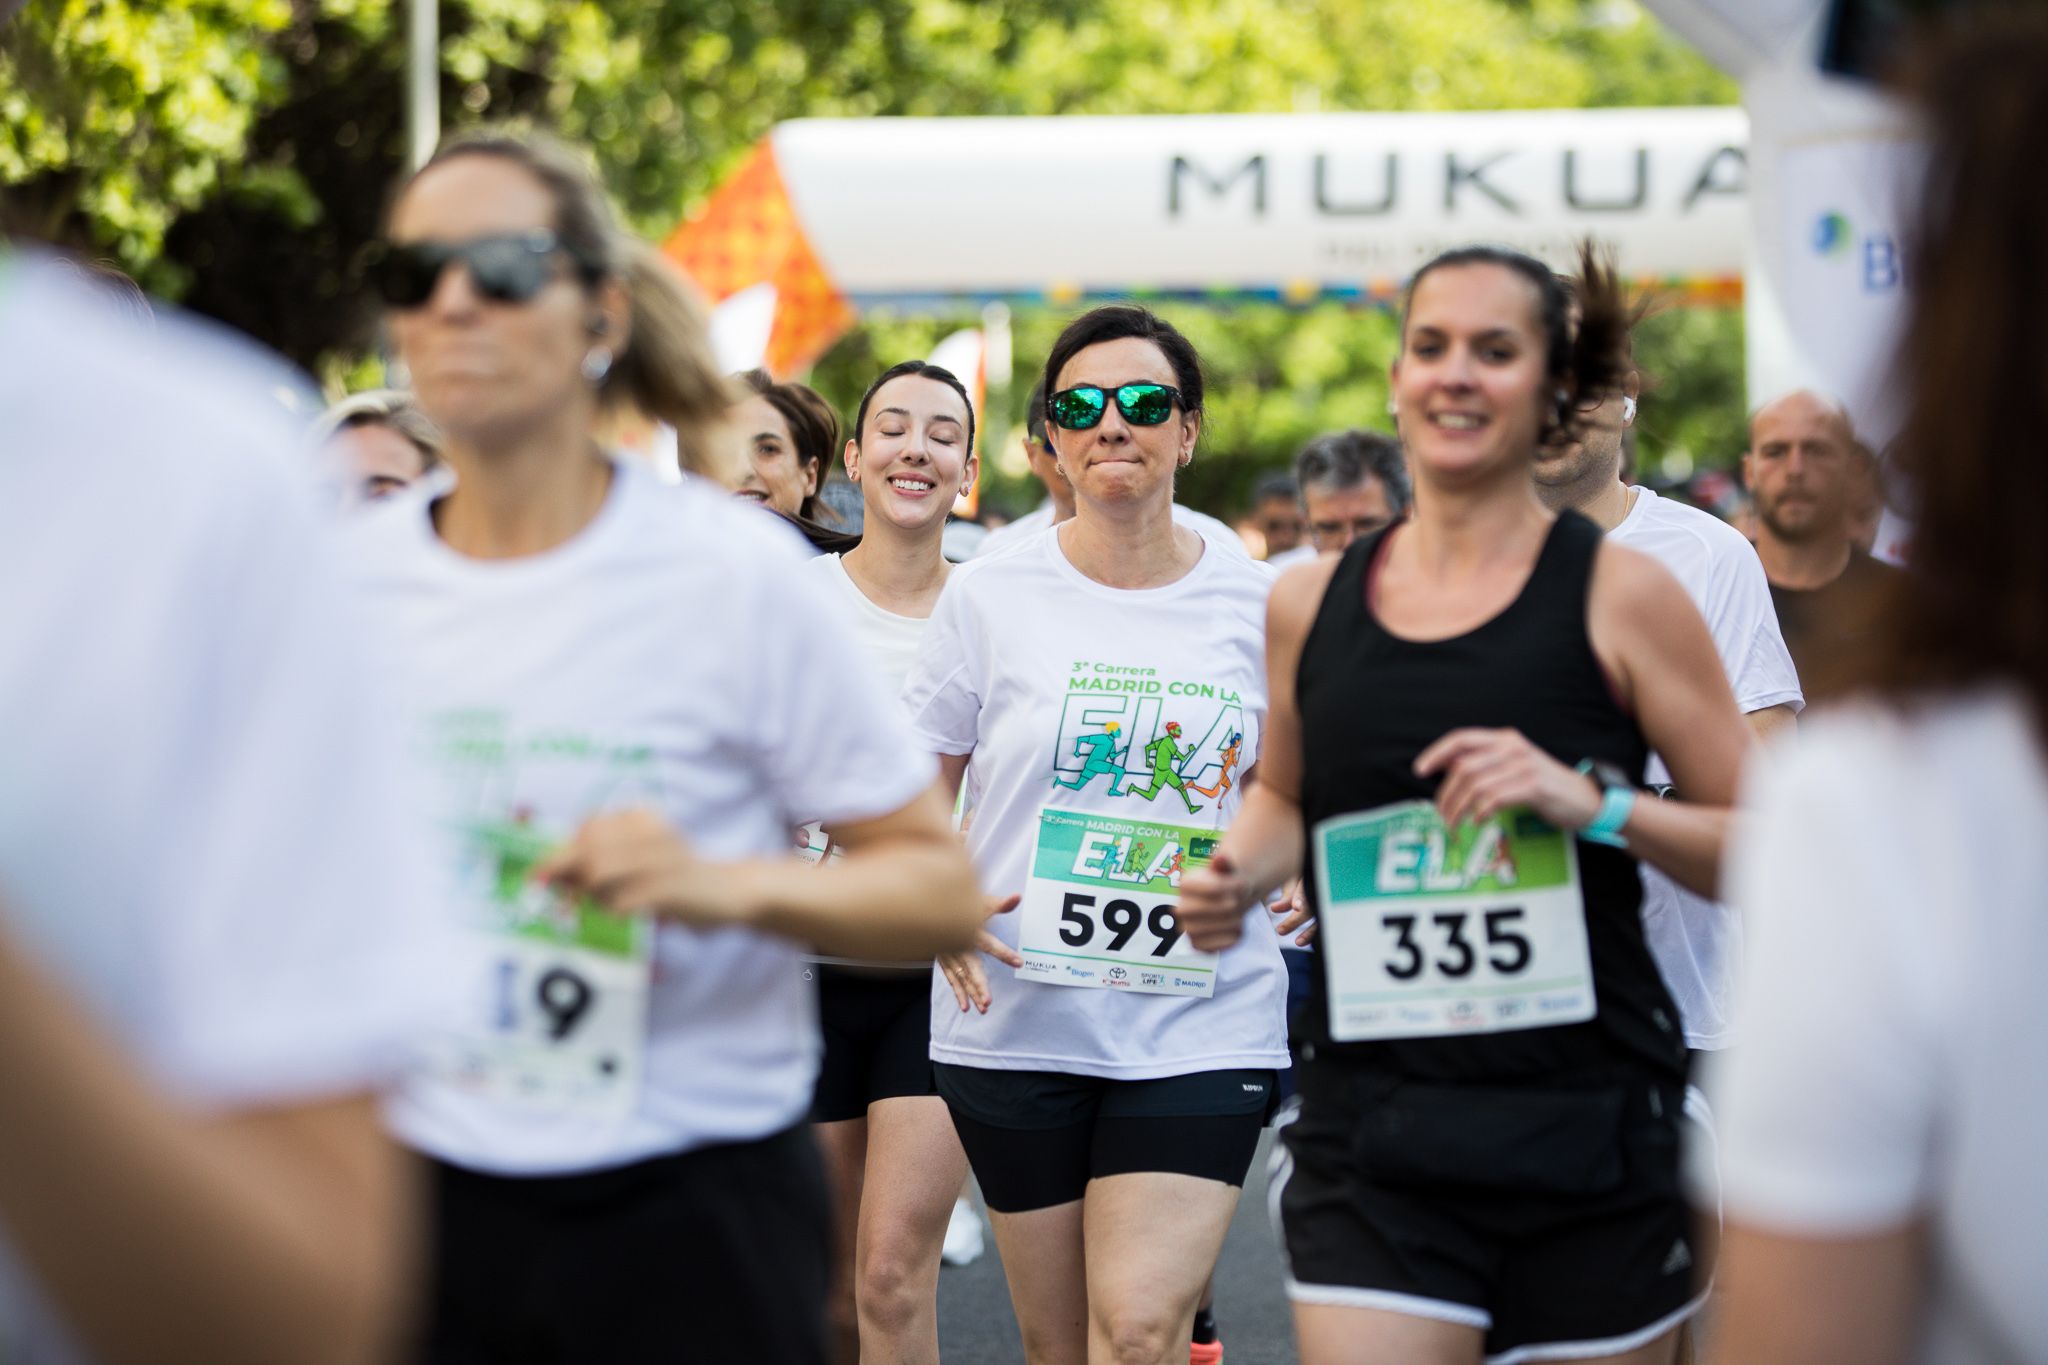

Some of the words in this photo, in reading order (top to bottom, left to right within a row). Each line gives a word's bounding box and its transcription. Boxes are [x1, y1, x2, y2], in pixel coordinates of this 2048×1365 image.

[1165, 146, 1748, 216] MUKUA
[1068, 677, 1162, 694] MADRID
[1167, 681, 1215, 699] CON
[1220, 687, 1242, 704] LA
[1093, 663, 1156, 677] Carrera
[1054, 693, 1245, 779] ELA
[1071, 830, 1182, 888] ELA
[1087, 820, 1135, 835] MADRID
[1136, 826, 1163, 838] CON
[1165, 830, 1180, 840] LA
[1376, 820, 1518, 893] ELA
[1058, 892, 1186, 958] 599
[1381, 906, 1532, 980] 335
[1071, 968, 1095, 978] Biogen
[1181, 979, 1206, 988] MADRID
